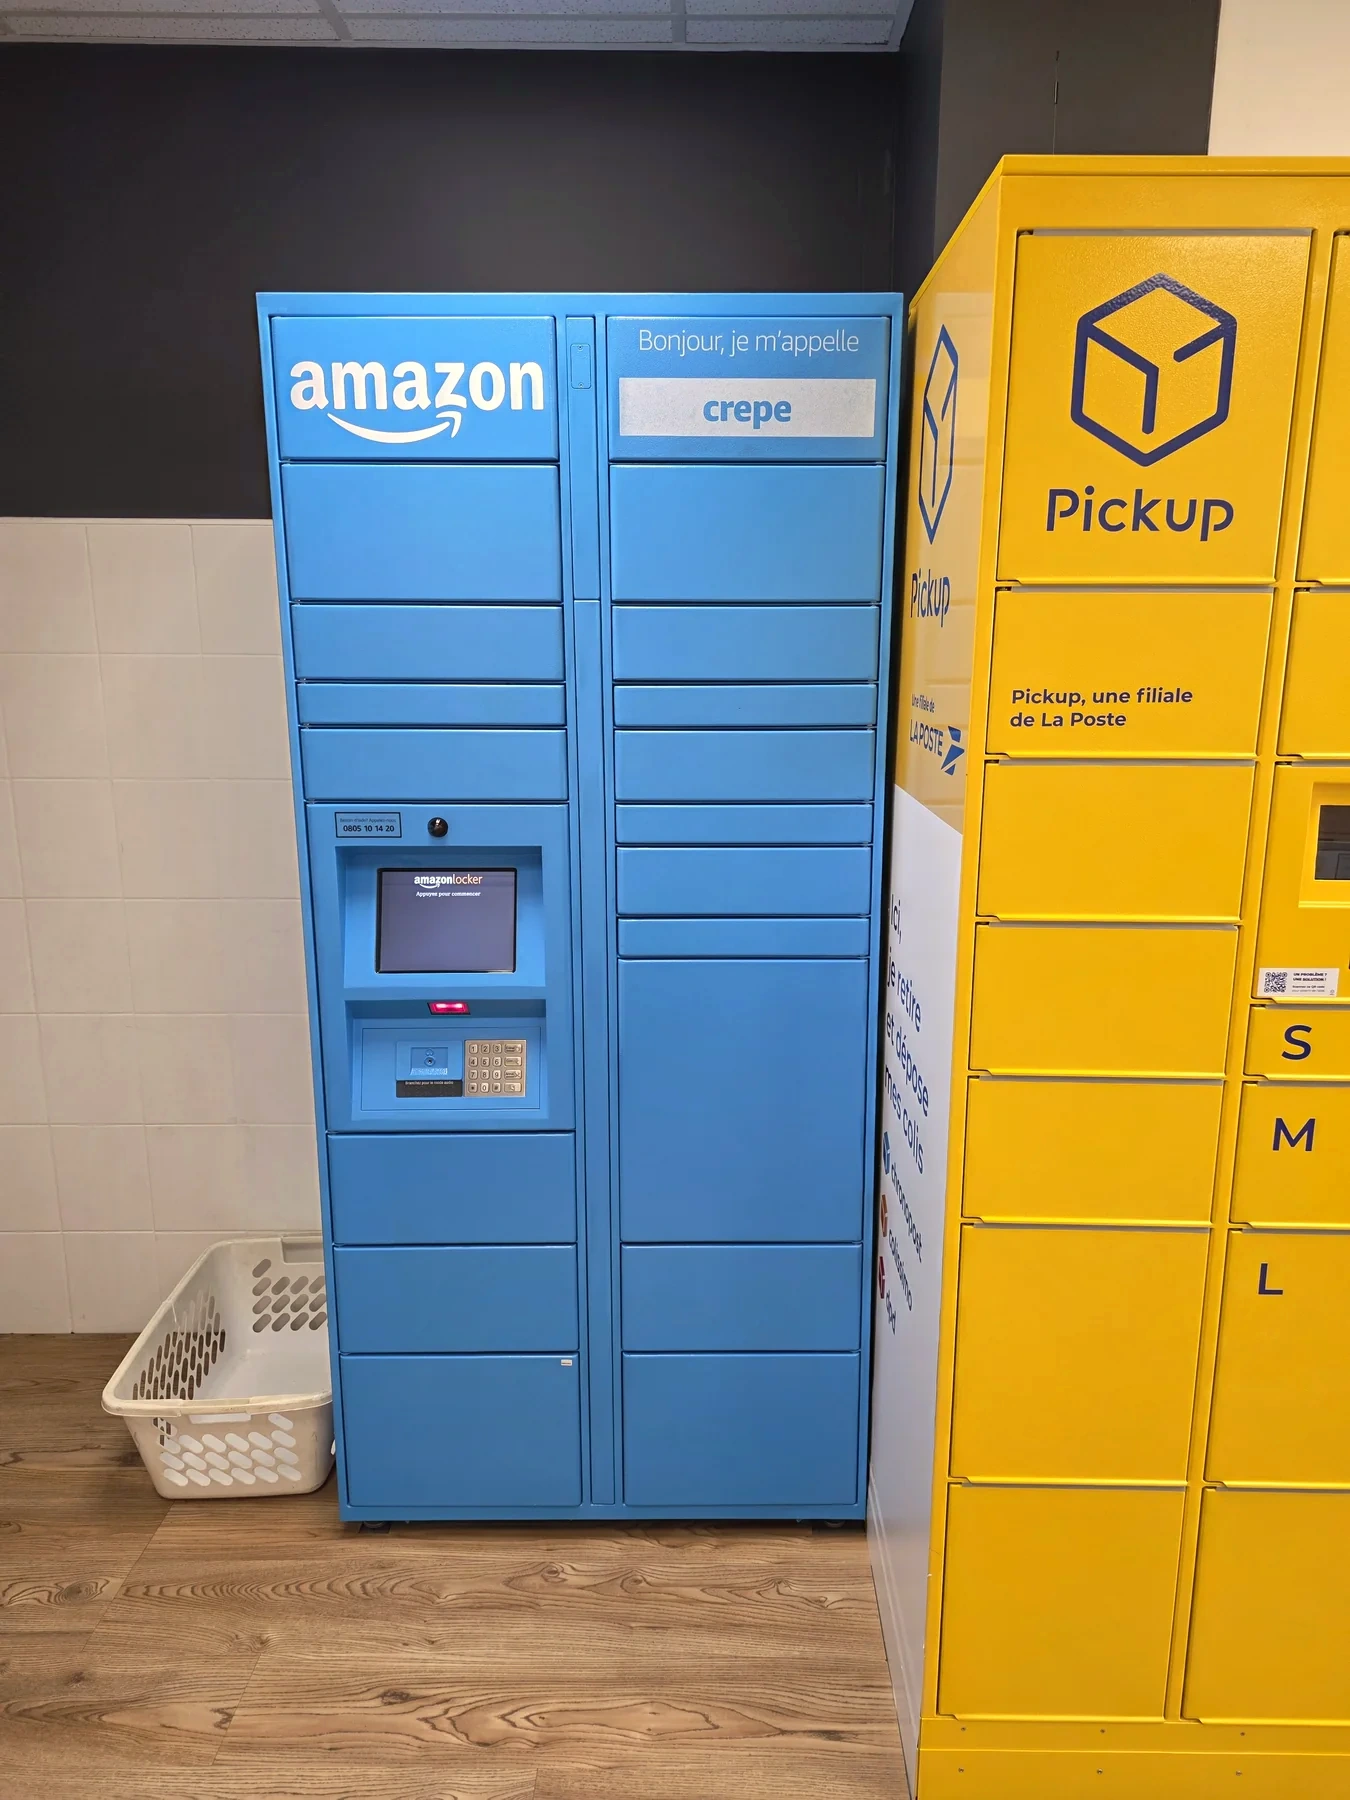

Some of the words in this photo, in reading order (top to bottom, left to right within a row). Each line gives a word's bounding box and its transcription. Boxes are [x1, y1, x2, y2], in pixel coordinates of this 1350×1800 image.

[638, 329, 724, 357] Bonjour,
[729, 330, 749, 357] je
[290, 359, 544, 411] amazon
[703, 400, 792, 429] crepe
[1046, 485, 1234, 541] Pickup
[910, 567, 950, 628] Pickup
[1010, 712, 1035, 727] de
[1041, 713, 1064, 727] La
[1070, 712, 1127, 727] Poste
[1011, 688, 1086, 707] Pickup,
[1092, 691, 1131, 703] une
[1136, 687, 1193, 703] filiale
[909, 719, 919, 744] LA
[918, 722, 943, 756] POSTE
[414, 873, 483, 886] amazonlocker
[890, 894, 902, 945] Ici,
[887, 946, 896, 988] je
[897, 970, 922, 1032] retire
[886, 1012, 895, 1046] et
[895, 1026, 929, 1118] dépose
[1281, 1024, 1313, 1061] S
[884, 1064, 902, 1120] mes
[902, 1108, 924, 1175] colis
[1272, 1118, 1316, 1151] M
[891, 1162, 923, 1264] chronopost
[889, 1228, 913, 1312] colissimo
[1258, 1263, 1284, 1296] L
[885, 1290, 897, 1336] dpd
